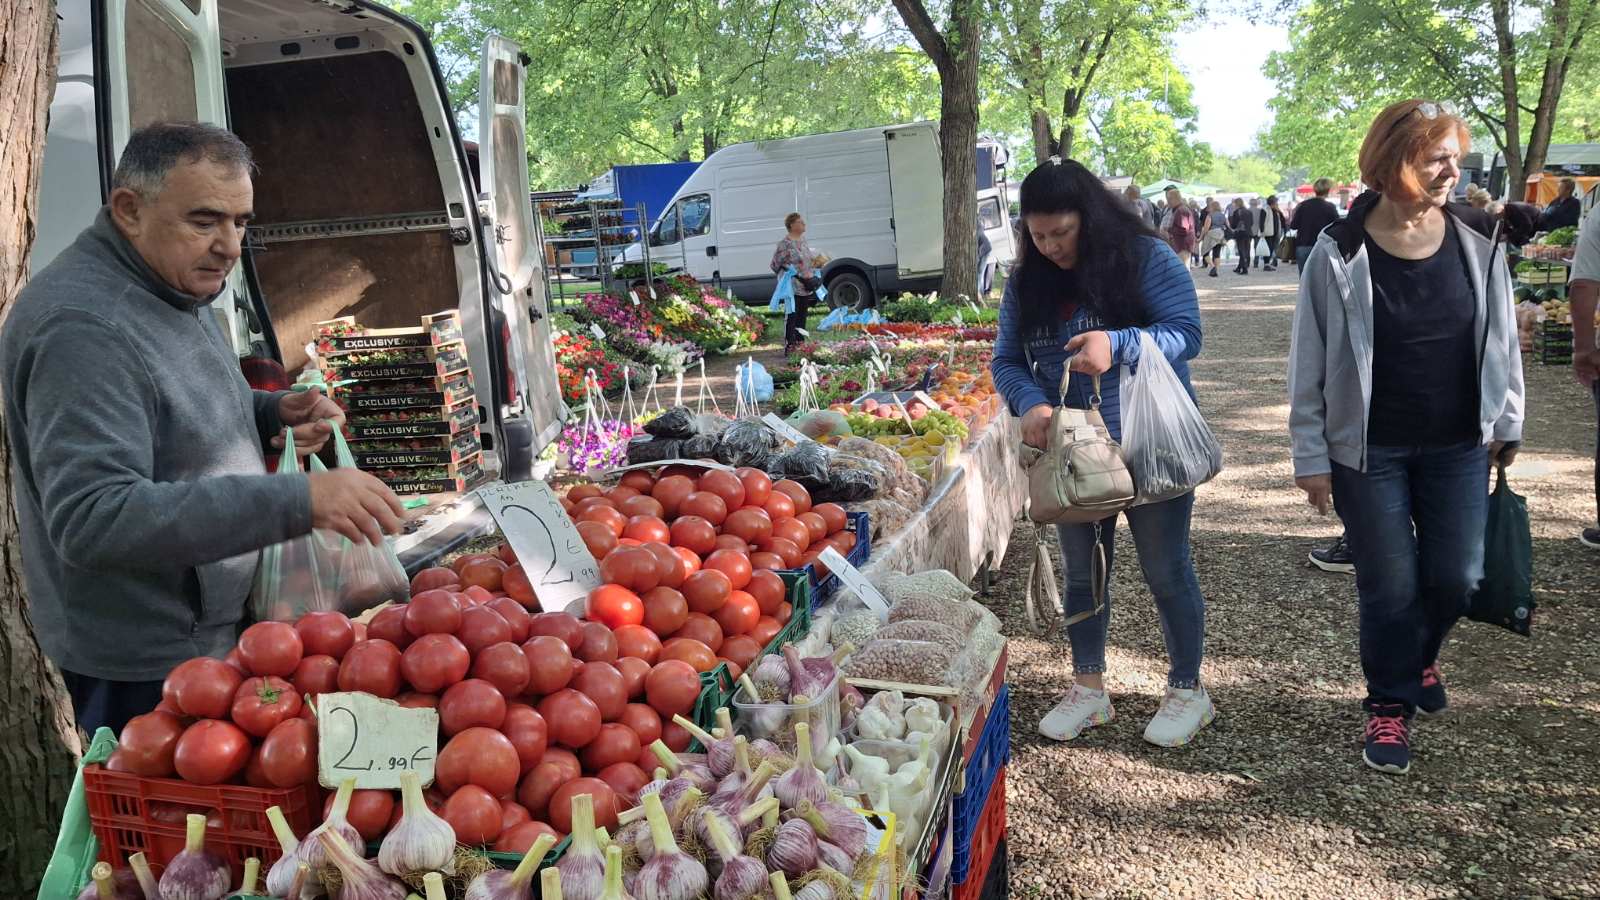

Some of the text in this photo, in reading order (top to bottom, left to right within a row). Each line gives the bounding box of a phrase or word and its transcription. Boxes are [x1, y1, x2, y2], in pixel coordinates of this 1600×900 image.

[344, 338, 401, 348] EXCLUSIVE
[351, 367, 408, 378] EXCLUSIVE
[358, 397, 415, 407] EXCLUSIVE
[363, 425, 419, 436] EXCLUSIVE
[366, 455, 421, 464] EXCLUSIVE
[389, 483, 428, 492] LUSIVE
